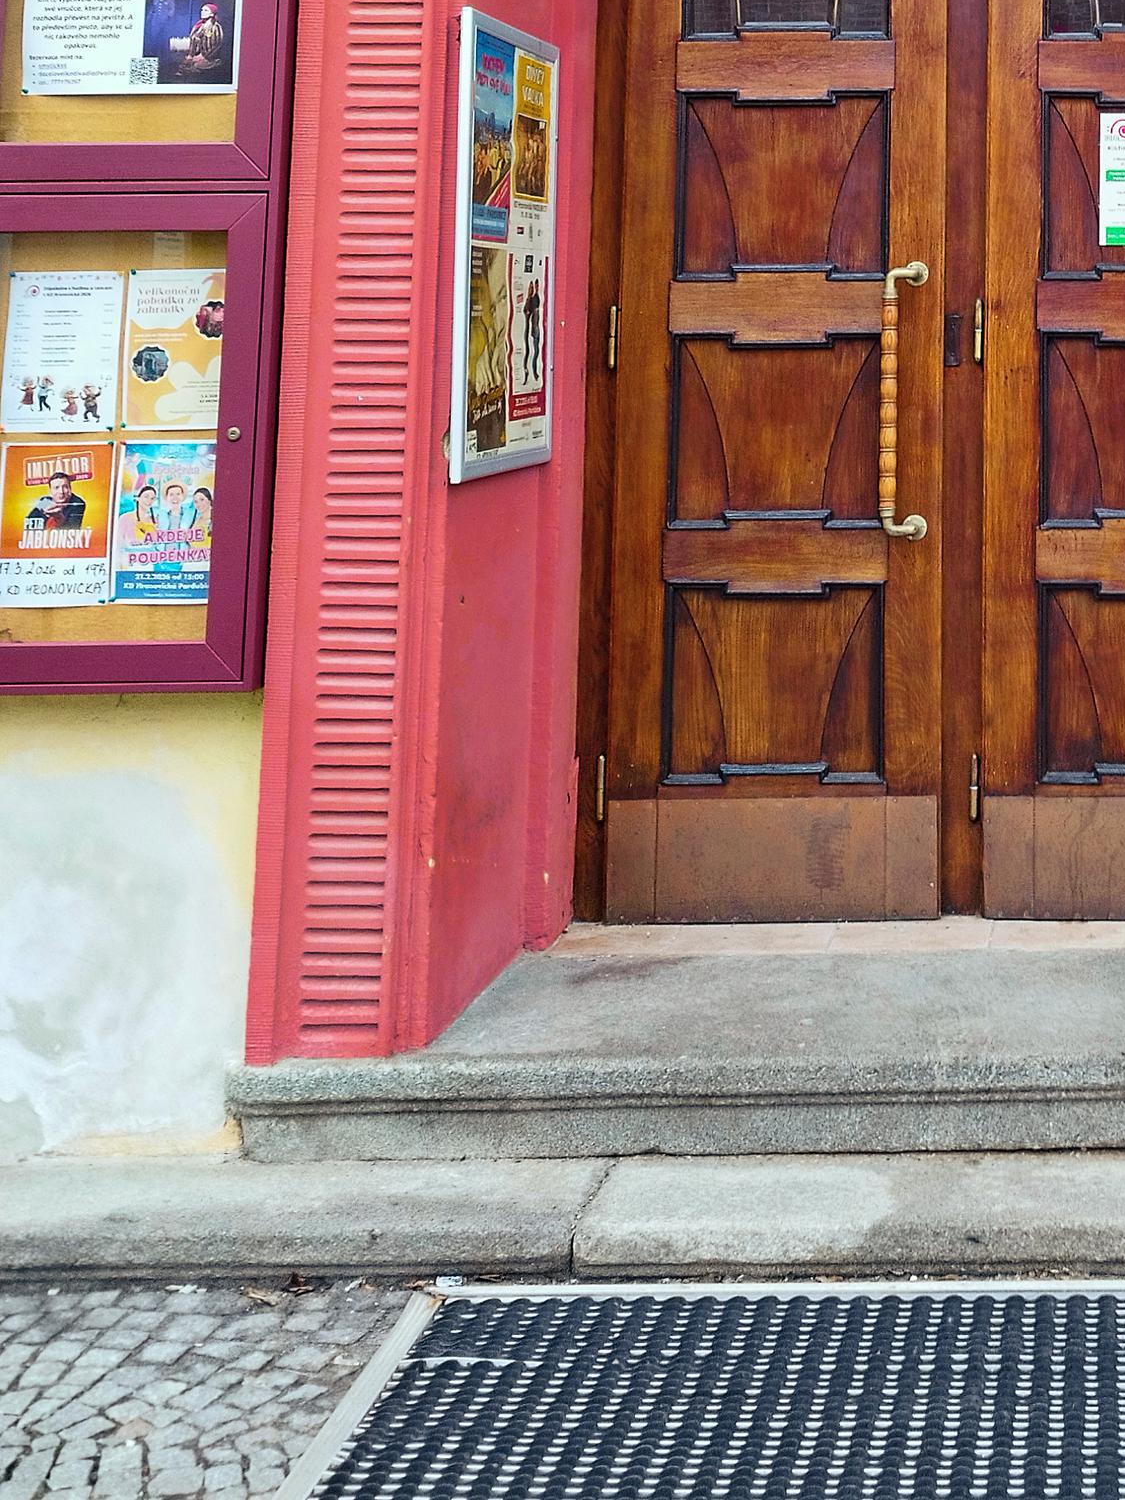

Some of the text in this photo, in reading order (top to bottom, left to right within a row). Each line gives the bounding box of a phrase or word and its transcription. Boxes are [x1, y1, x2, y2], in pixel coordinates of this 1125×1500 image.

[27, 456, 89, 479] IMITÁTOR
[18, 526, 92, 549] JABLONSKÝ
[144, 529, 204, 544] A KDE JE
[26, 581, 106, 595] HRONOVICKÁ
